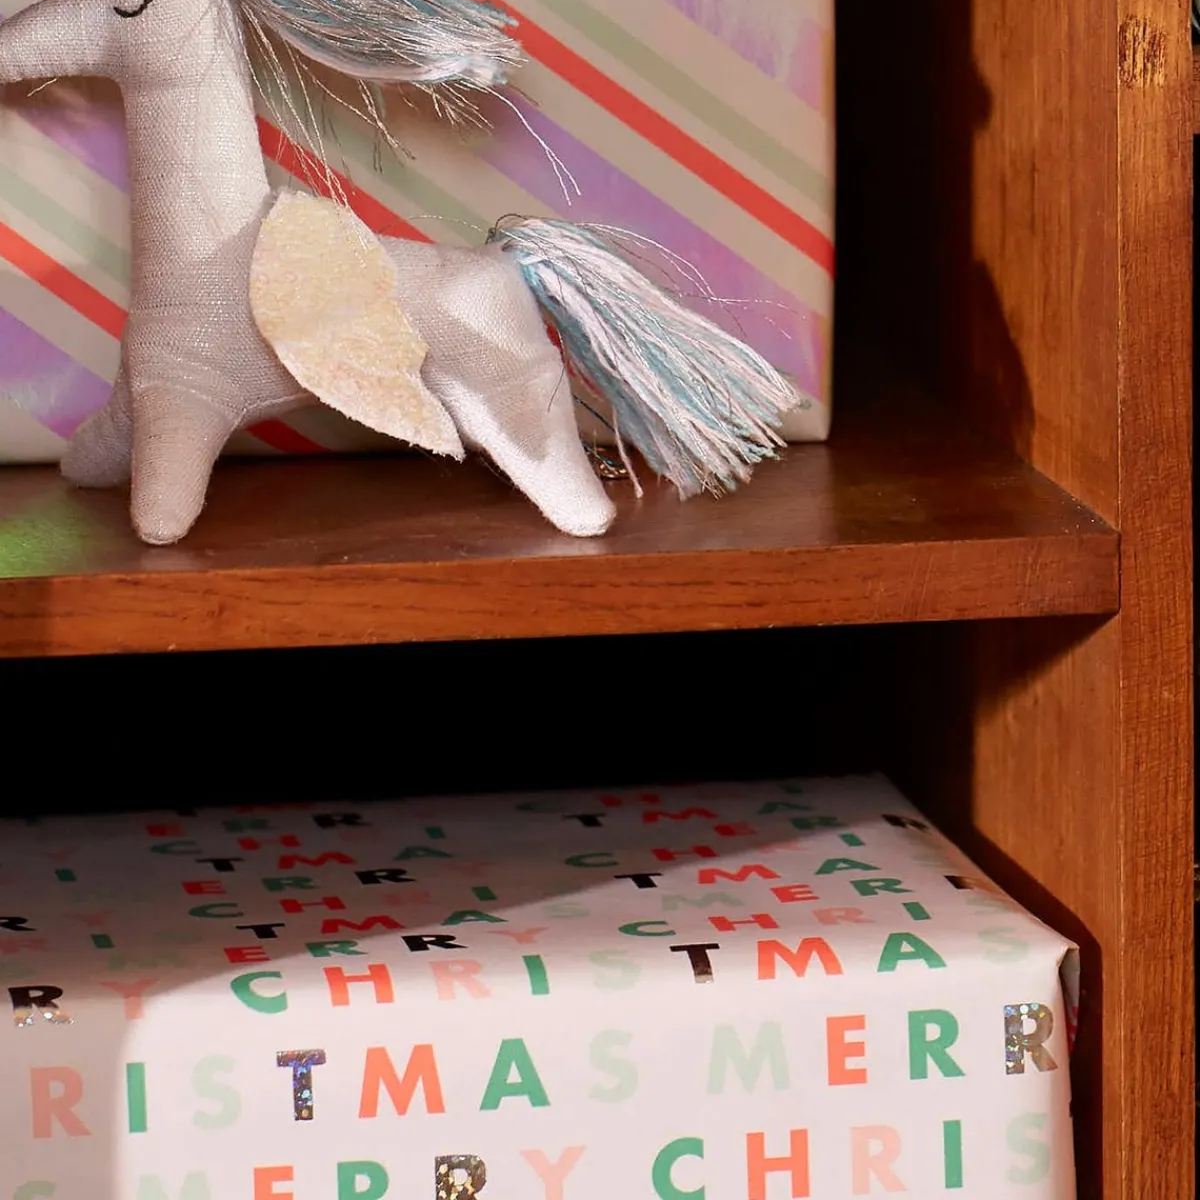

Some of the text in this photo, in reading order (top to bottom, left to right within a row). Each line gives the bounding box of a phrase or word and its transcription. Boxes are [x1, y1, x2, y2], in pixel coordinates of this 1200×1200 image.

[229, 926, 1031, 1016] CHRISTMAS
[29, 1002, 1061, 1140] RISTMAS MERR
